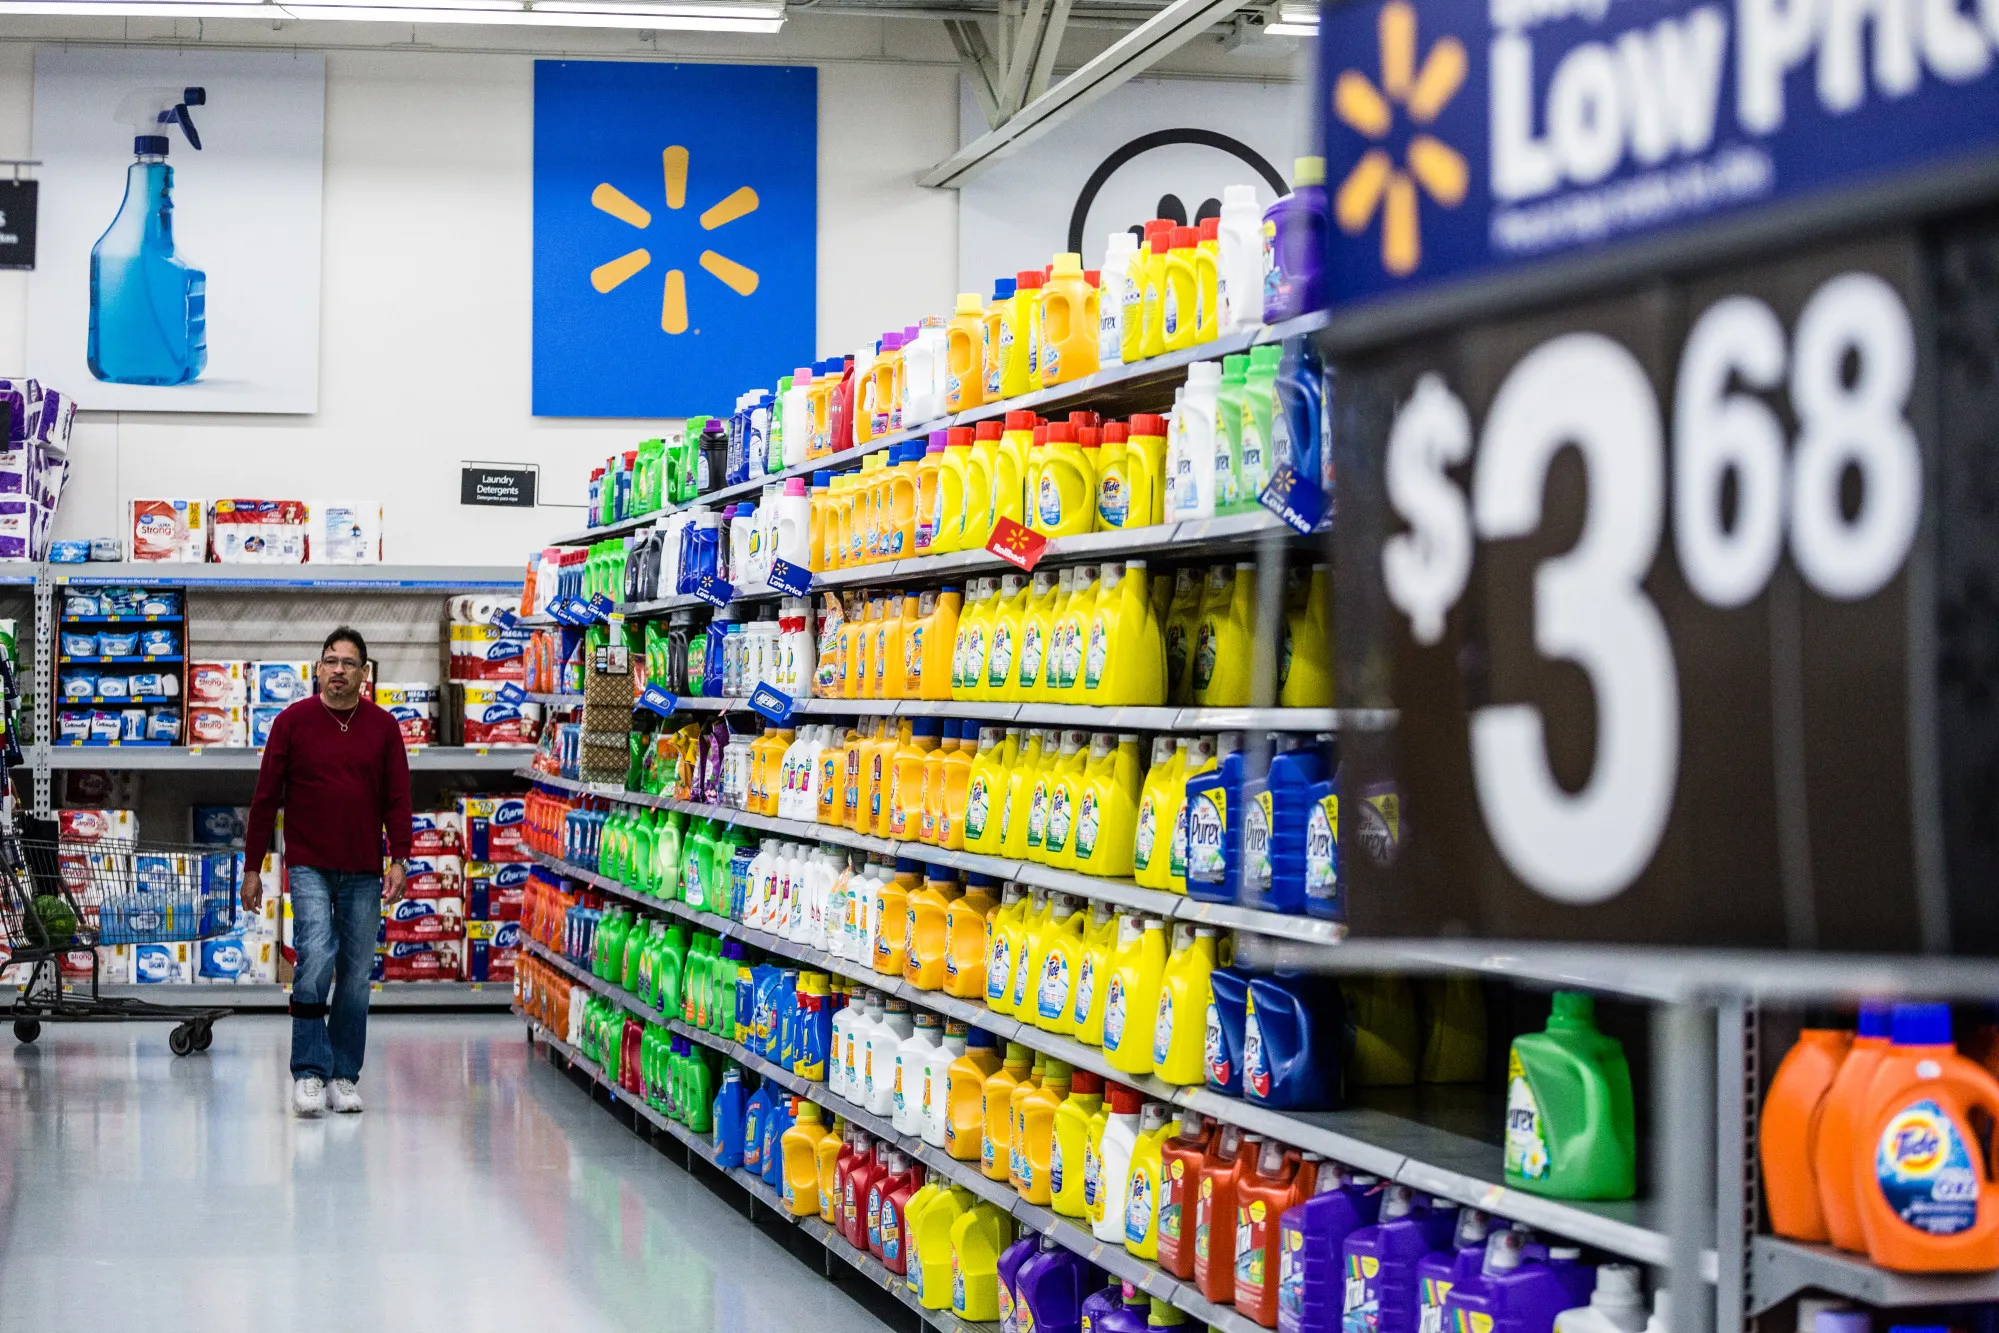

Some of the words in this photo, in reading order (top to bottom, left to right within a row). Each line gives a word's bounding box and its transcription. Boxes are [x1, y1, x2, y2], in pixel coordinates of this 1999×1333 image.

[1736, 0, 1999, 136] Pric
[482, 475, 514, 486] Laundry
[1103, 480, 1120, 494] Tide
[477, 485, 518, 496] Detergents
[141, 526, 172, 536] Strong
[993, 543, 1027, 567] Rollback
[770, 577, 785, 588] Low
[784, 584, 803, 597] Price
[696, 588, 710, 600] Low
[708, 594, 725, 608] Price
[486, 628, 498, 638] 36
[501, 630, 523, 638] MEGA
[489, 643, 519, 657] Charmin
[392, 691, 404, 701] 24
[407, 690, 426, 698] MEGA
[482, 692, 494, 700] 36
[646, 691, 664, 705] NEW
[756, 693, 778, 708] NEW
[485, 706, 515, 720] Charmin
[480, 802, 492, 812] 72
[498, 805, 524, 822] Charm
[412, 819, 428, 829] rmin
[1190, 813, 1220, 846] Purex
[1246, 818, 1266, 852] Purex
[1306, 823, 1332, 858] Purex
[408, 861, 425, 872] rmin
[482, 864, 494, 874] 72
[399, 904, 426, 918] Charmin
[481, 924, 494, 934] 72
[1048, 960, 1060, 980] Tide
[1896, 1129, 1940, 1162] Tide
